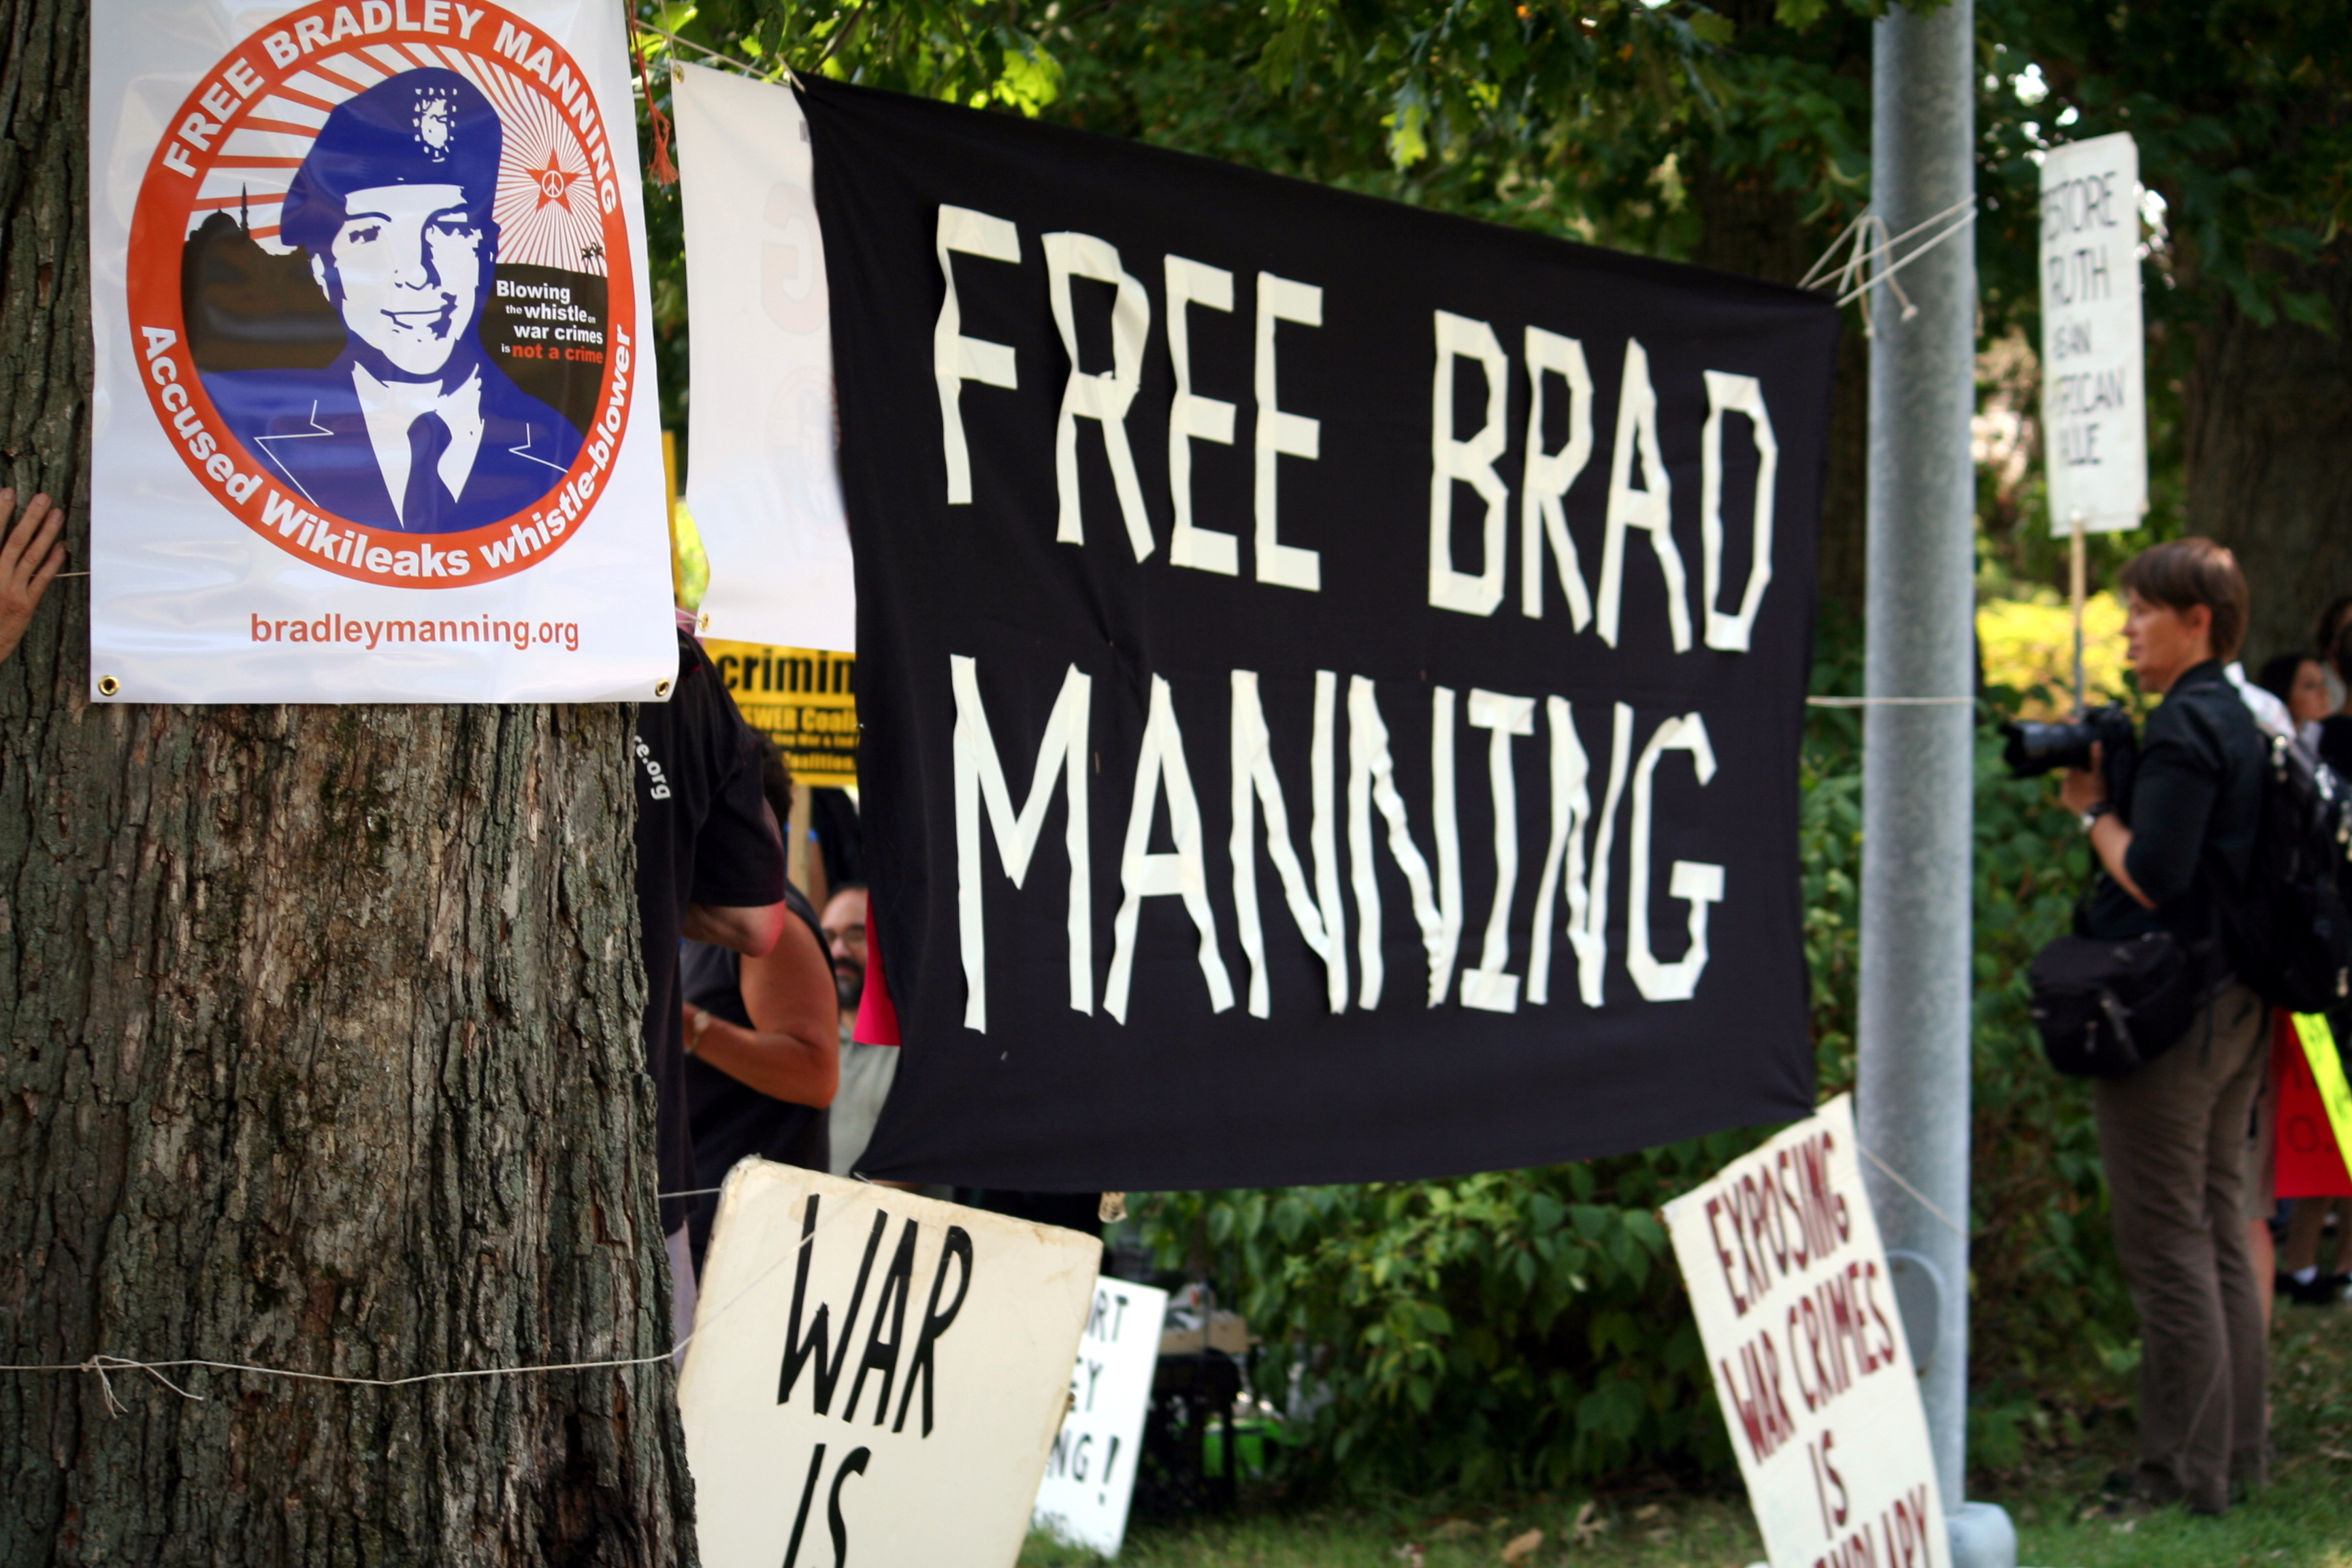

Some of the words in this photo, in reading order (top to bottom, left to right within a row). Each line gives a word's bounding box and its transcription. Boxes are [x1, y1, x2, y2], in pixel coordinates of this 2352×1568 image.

[162, 57, 263, 178] FREE
[263, 0, 485, 70] BRADLEY
[493, 20, 617, 214] MANNING
[496, 280, 570, 304] Blowing
[501, 343, 510, 353] is
[512, 343, 543, 359] not
[548, 346, 559, 360] a
[565, 346, 604, 364] crime
[506, 305, 523, 314] the
[523, 303, 587, 323] whistle
[587, 316, 596, 324] on
[513, 325, 549, 340] war
[554, 325, 604, 344] crimes
[142, 325, 261, 505] Accused
[259, 489, 471, 578] Wikileaks
[480, 325, 632, 569] whistle-blower
[934, 203, 1324, 591] FREE
[1429, 309, 1778, 653] BRAD
[251, 612, 580, 651] bradleymanning.org
[716, 648, 855, 695] crimin
[950, 653, 1725, 1034] MANNING
[1704, 1129, 1851, 1318] EXPOSING
[777, 1192, 974, 1439] WAR
[1720, 1330, 1796, 1465] WAR
[1787, 1260, 1895, 1414] CRIMES
[782, 1442, 871, 1568] IS
[1808, 1429, 1850, 1541] IS
